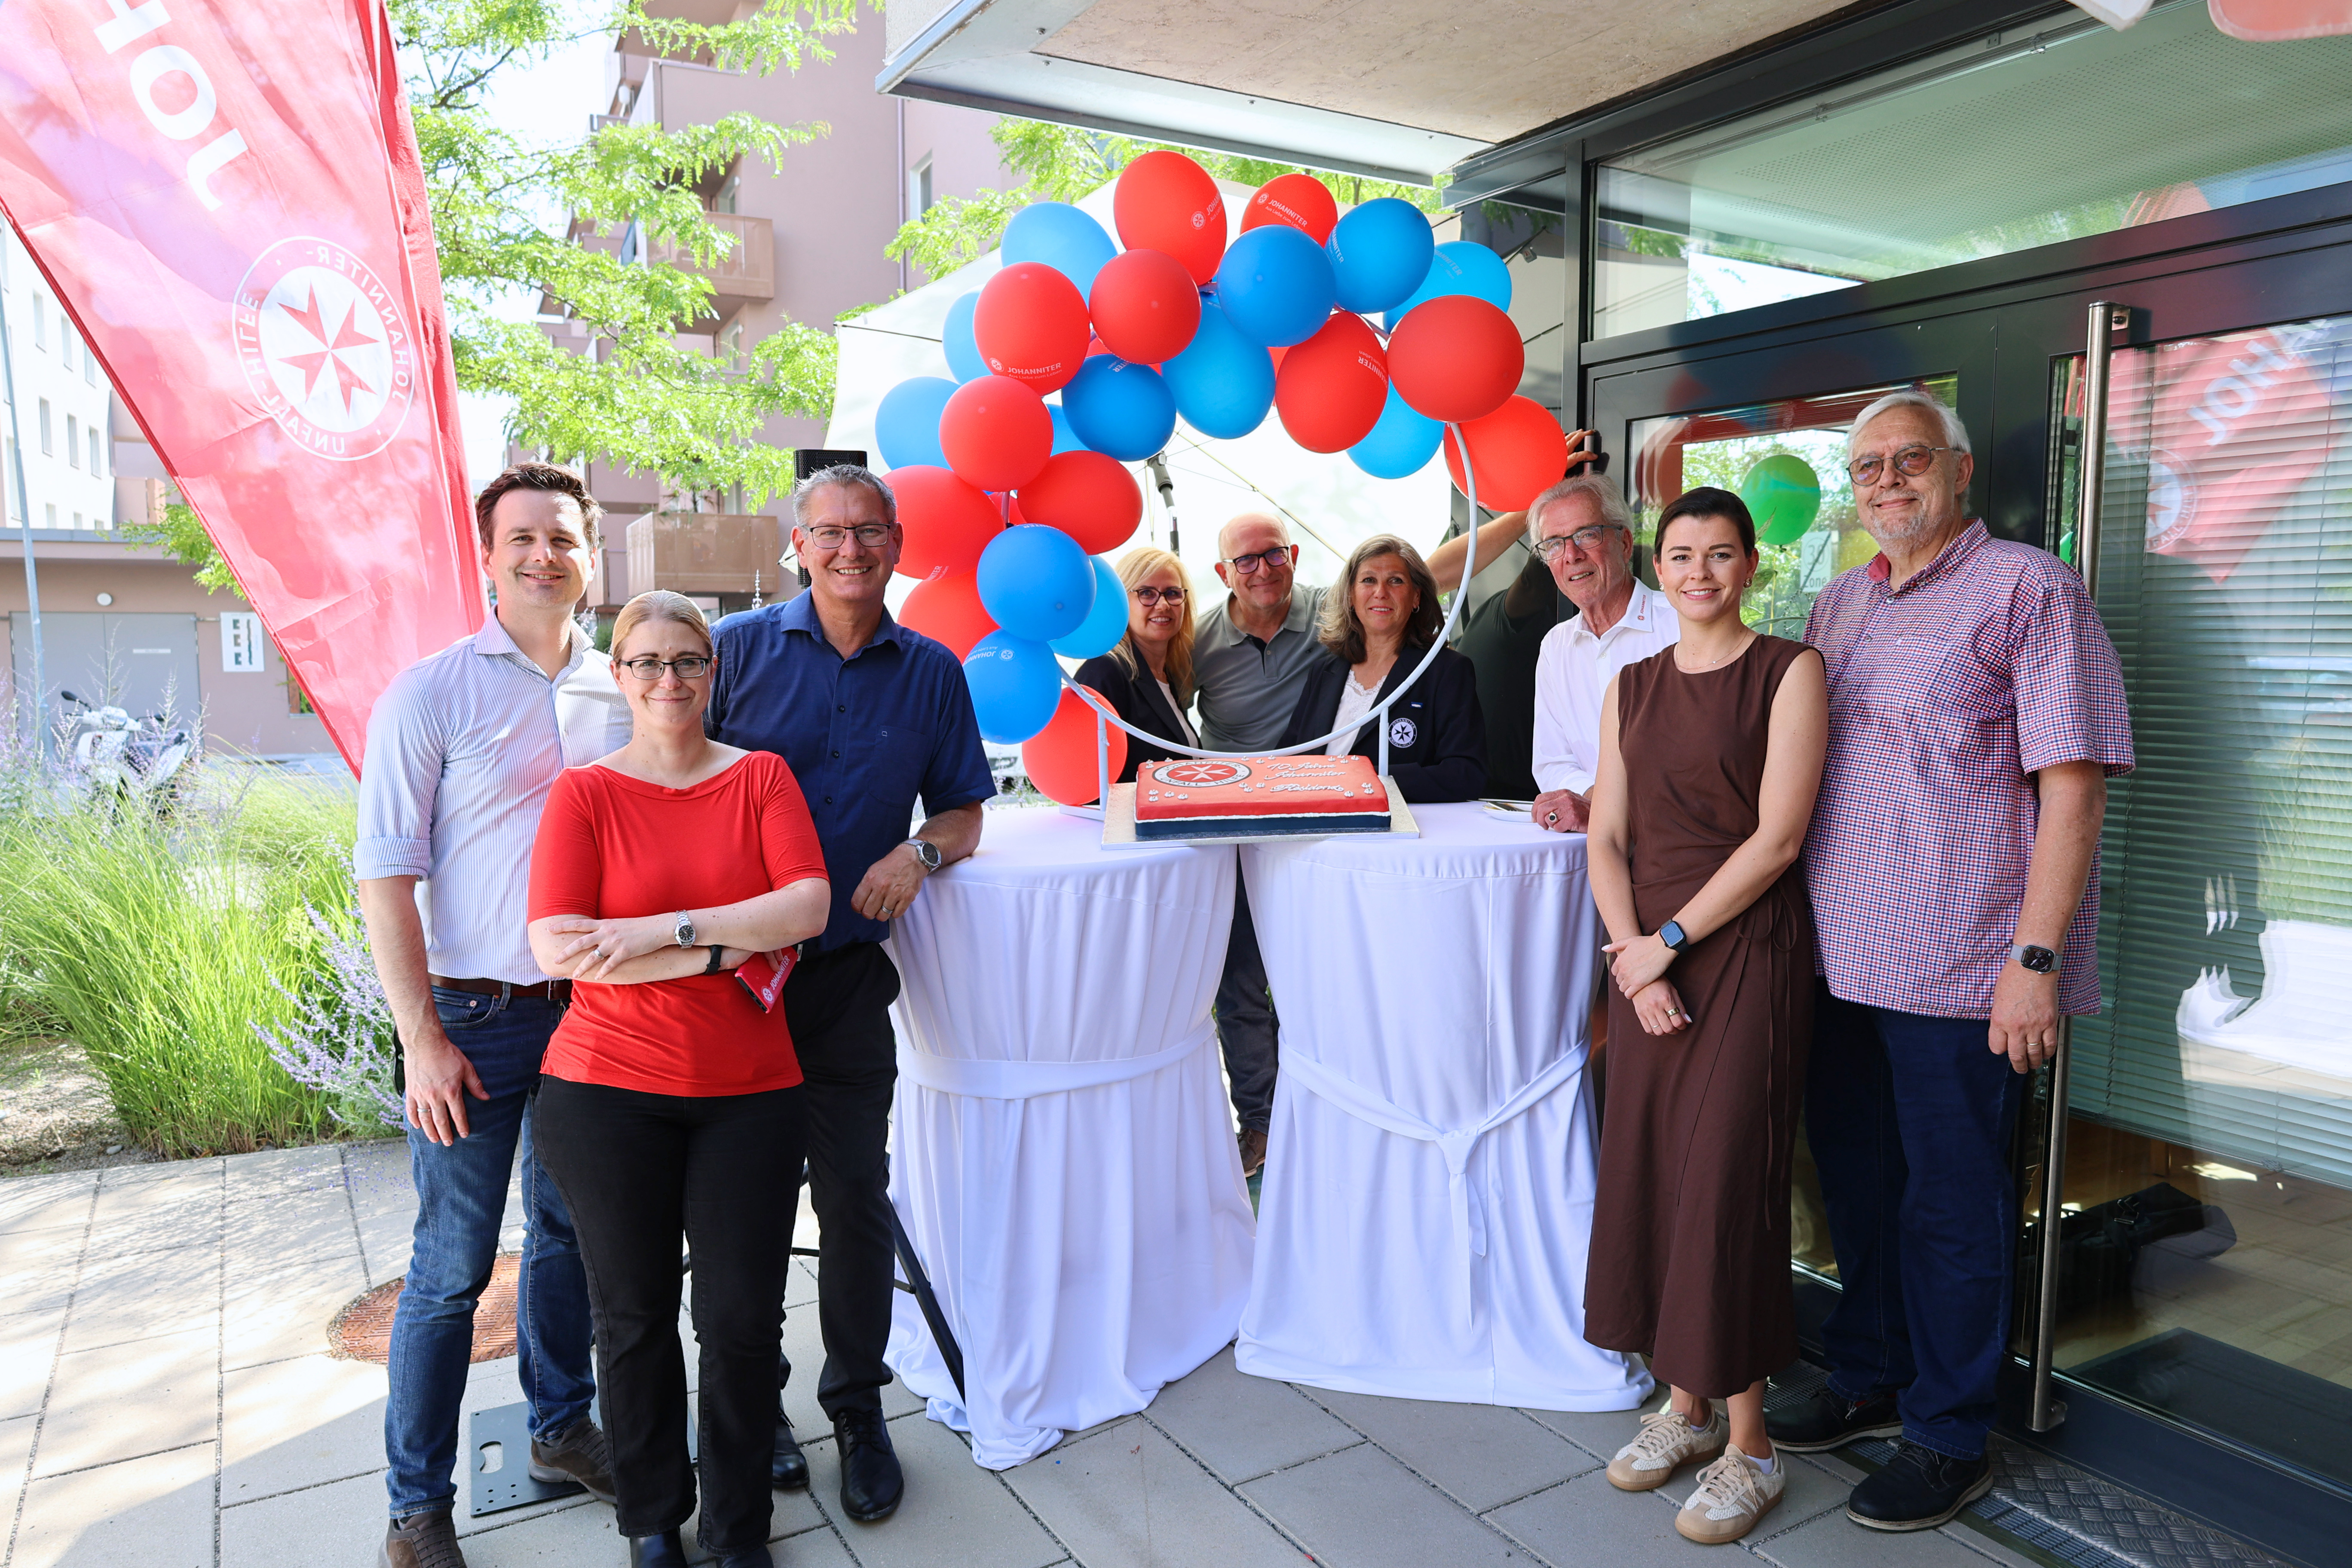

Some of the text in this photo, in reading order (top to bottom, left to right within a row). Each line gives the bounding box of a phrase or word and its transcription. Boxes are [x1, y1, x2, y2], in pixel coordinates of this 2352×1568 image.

[1268, 199, 1308, 227] JOHANNITER
[1272, 209, 1283, 217] Liebe
[1007, 362, 1061, 375] JOHANNITER
[1047, 369, 1063, 377] Leben
[1807, 544, 1825, 565] 30
[1264, 771, 1346, 780] Johanniter
[770, 955, 790, 990] JOHANNITER
